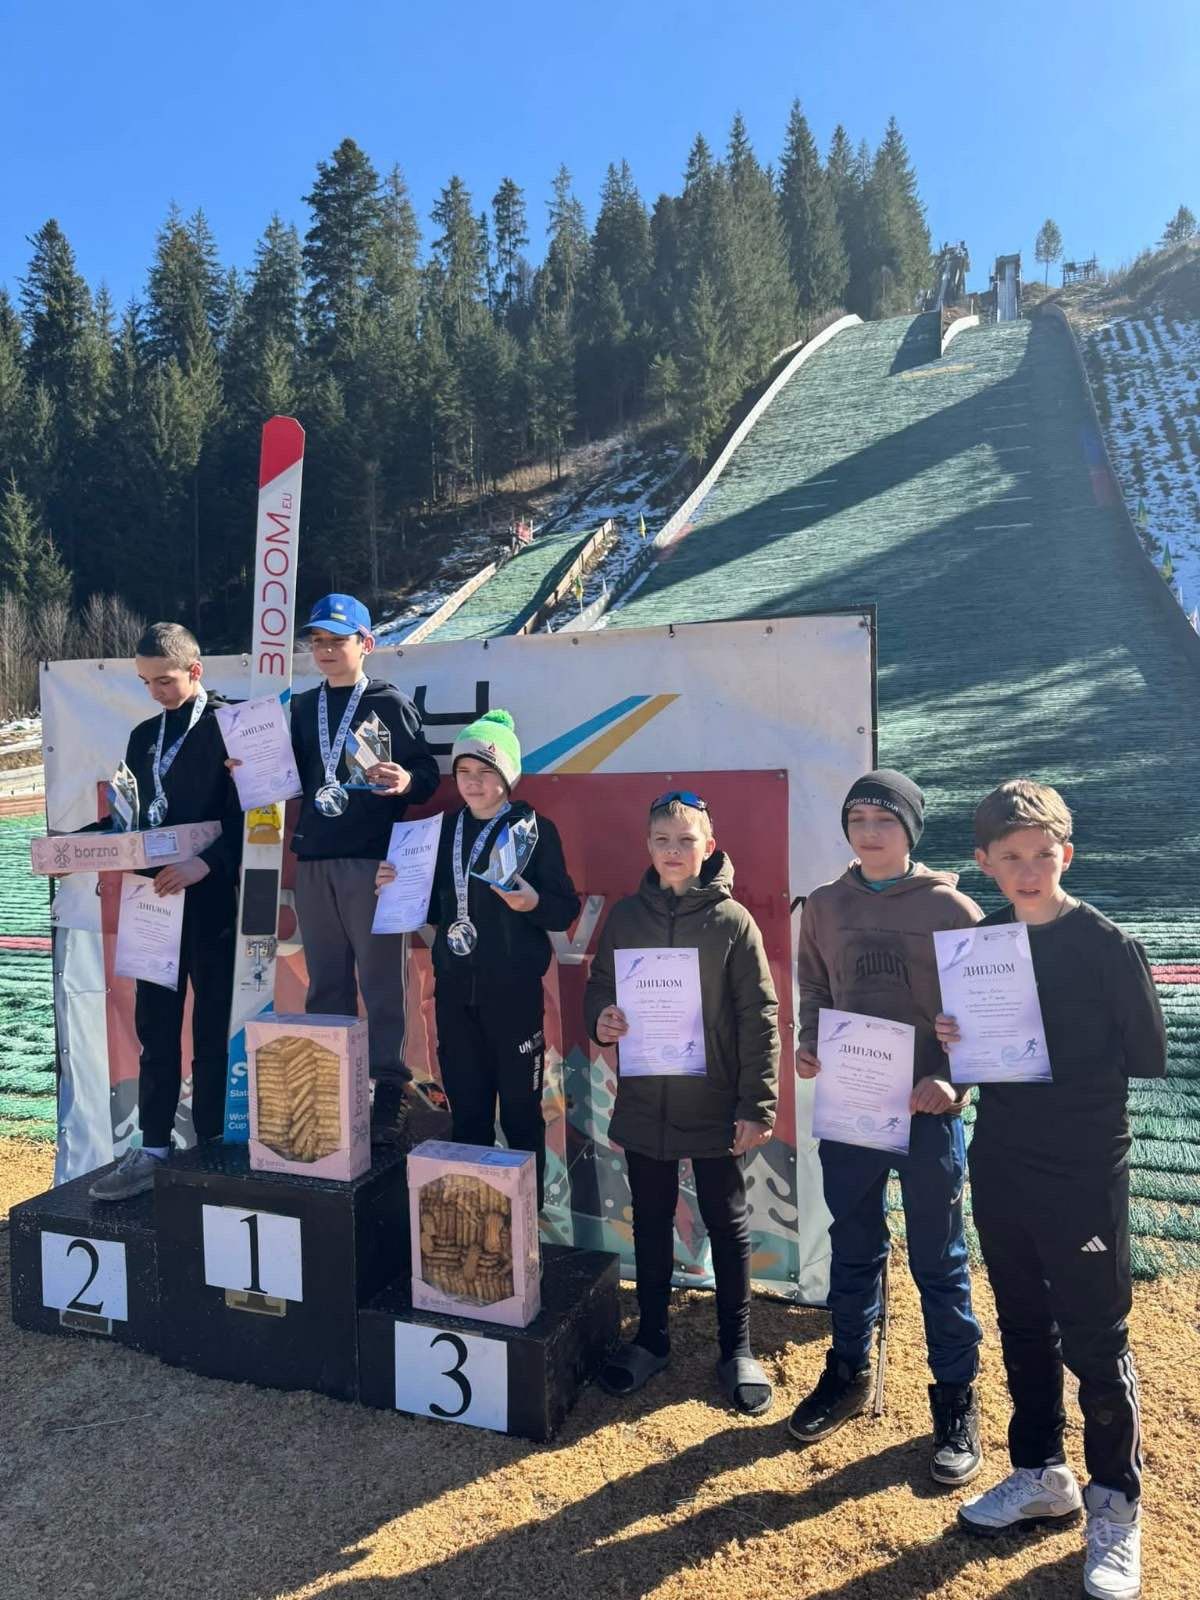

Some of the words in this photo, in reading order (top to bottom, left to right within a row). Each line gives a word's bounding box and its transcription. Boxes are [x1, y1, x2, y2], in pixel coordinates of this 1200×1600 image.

[240, 721, 275, 738] ДИПЛОМ
[74, 844, 119, 859] borzna
[401, 843, 432, 857] ДИПЛОМ
[136, 901, 172, 917] ДИПЛОМ
[962, 962, 1016, 978] ДИПЛОМ
[635, 978, 682, 990] ДИПЛОМ
[838, 1042, 892, 1061] ДИПЛОМ
[228, 1121, 248, 1130] Cup
[240, 1213, 268, 1294] 1
[66, 1238, 104, 1315] 2
[428, 1332, 472, 1418] 3
